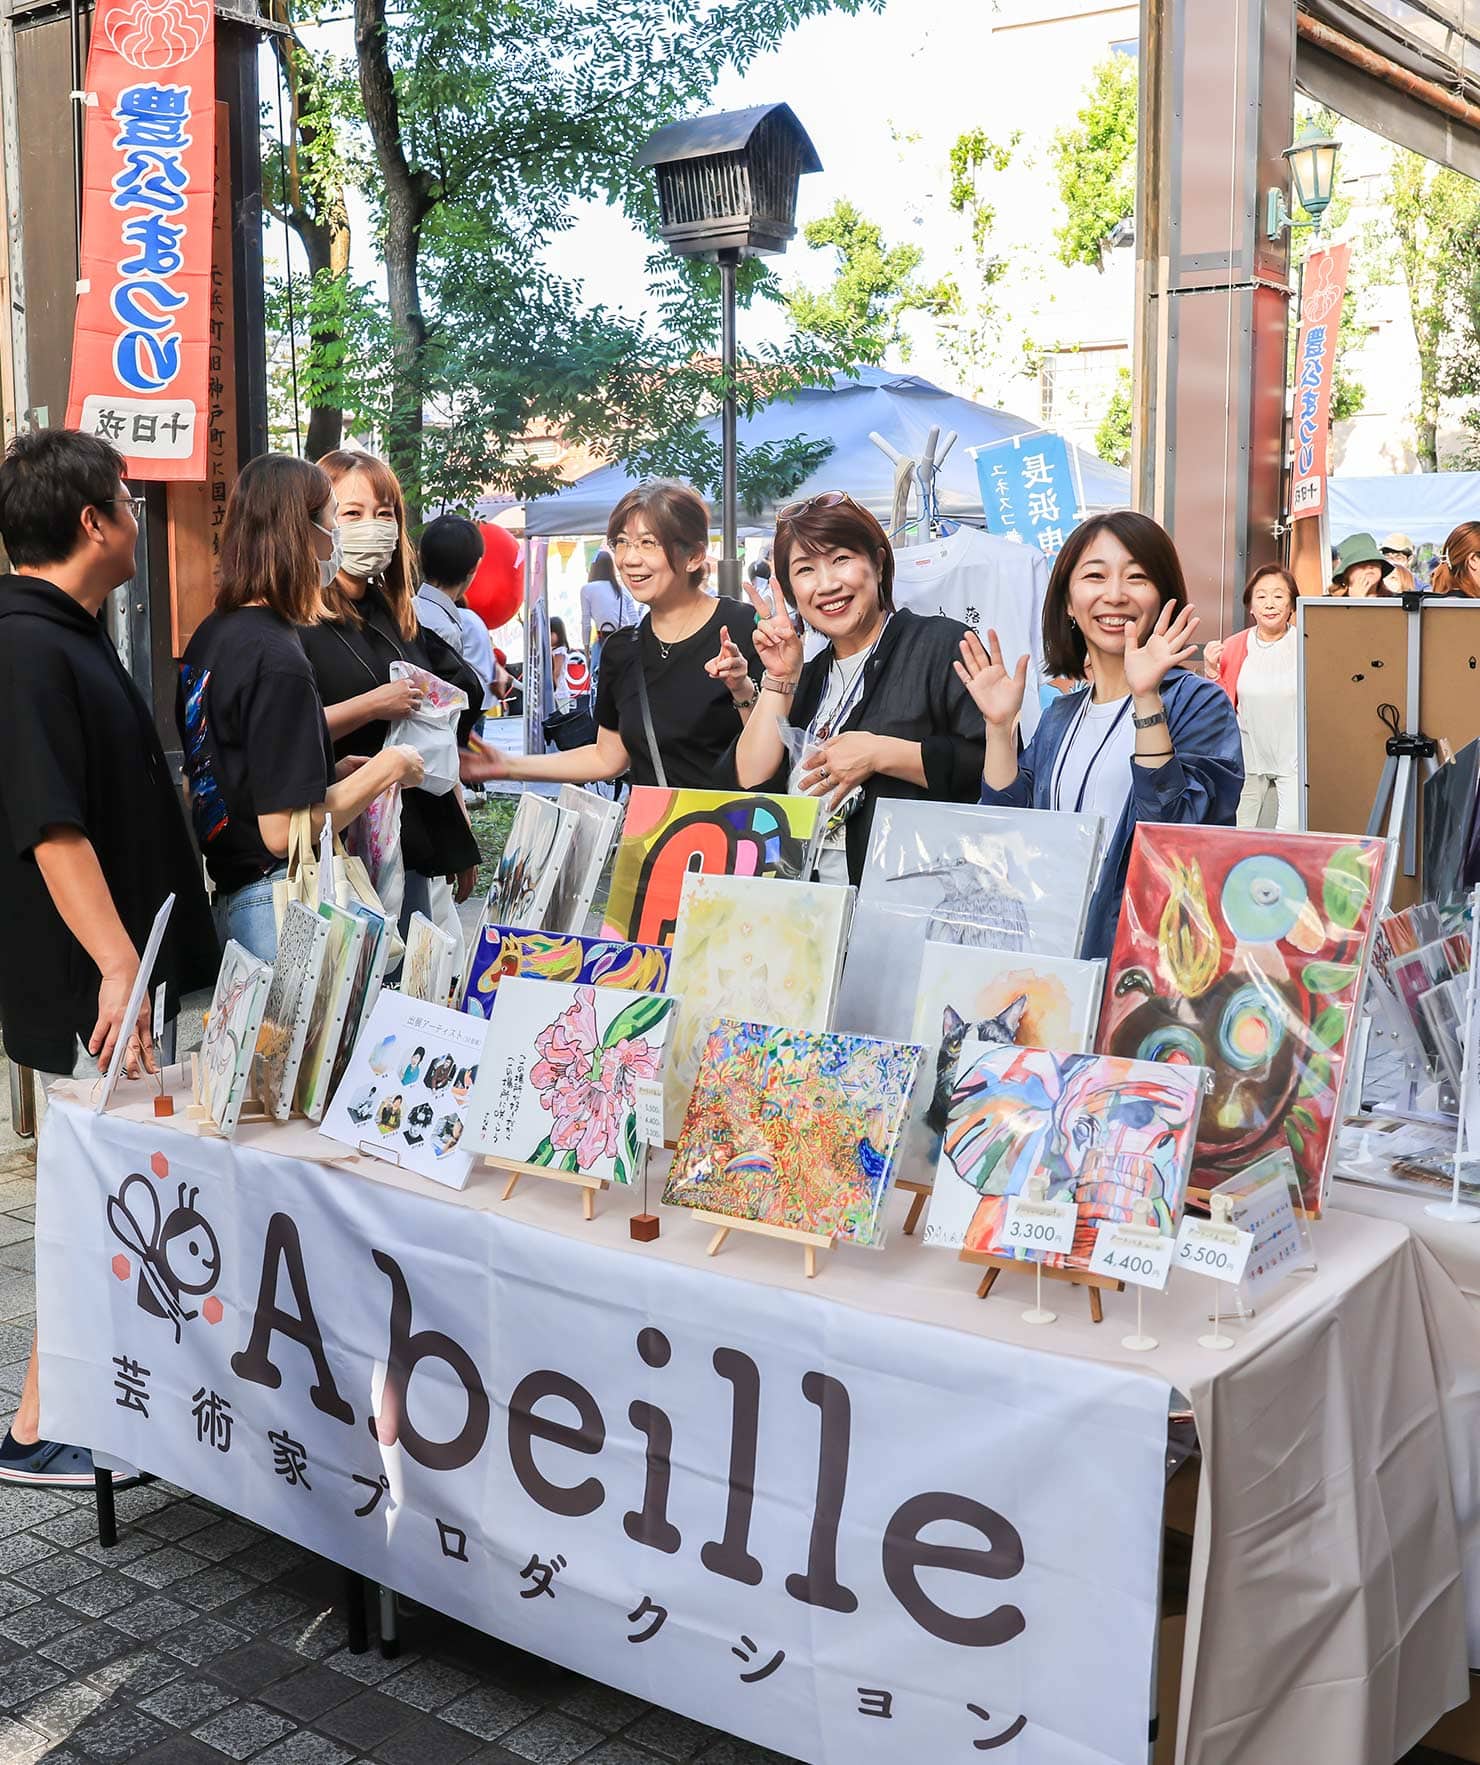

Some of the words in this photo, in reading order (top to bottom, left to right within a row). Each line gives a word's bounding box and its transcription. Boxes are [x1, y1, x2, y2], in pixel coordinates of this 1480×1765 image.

[112, 1355, 1027, 1750] 芸術家プロダクション
[230, 1212, 1026, 1646] Abeille
